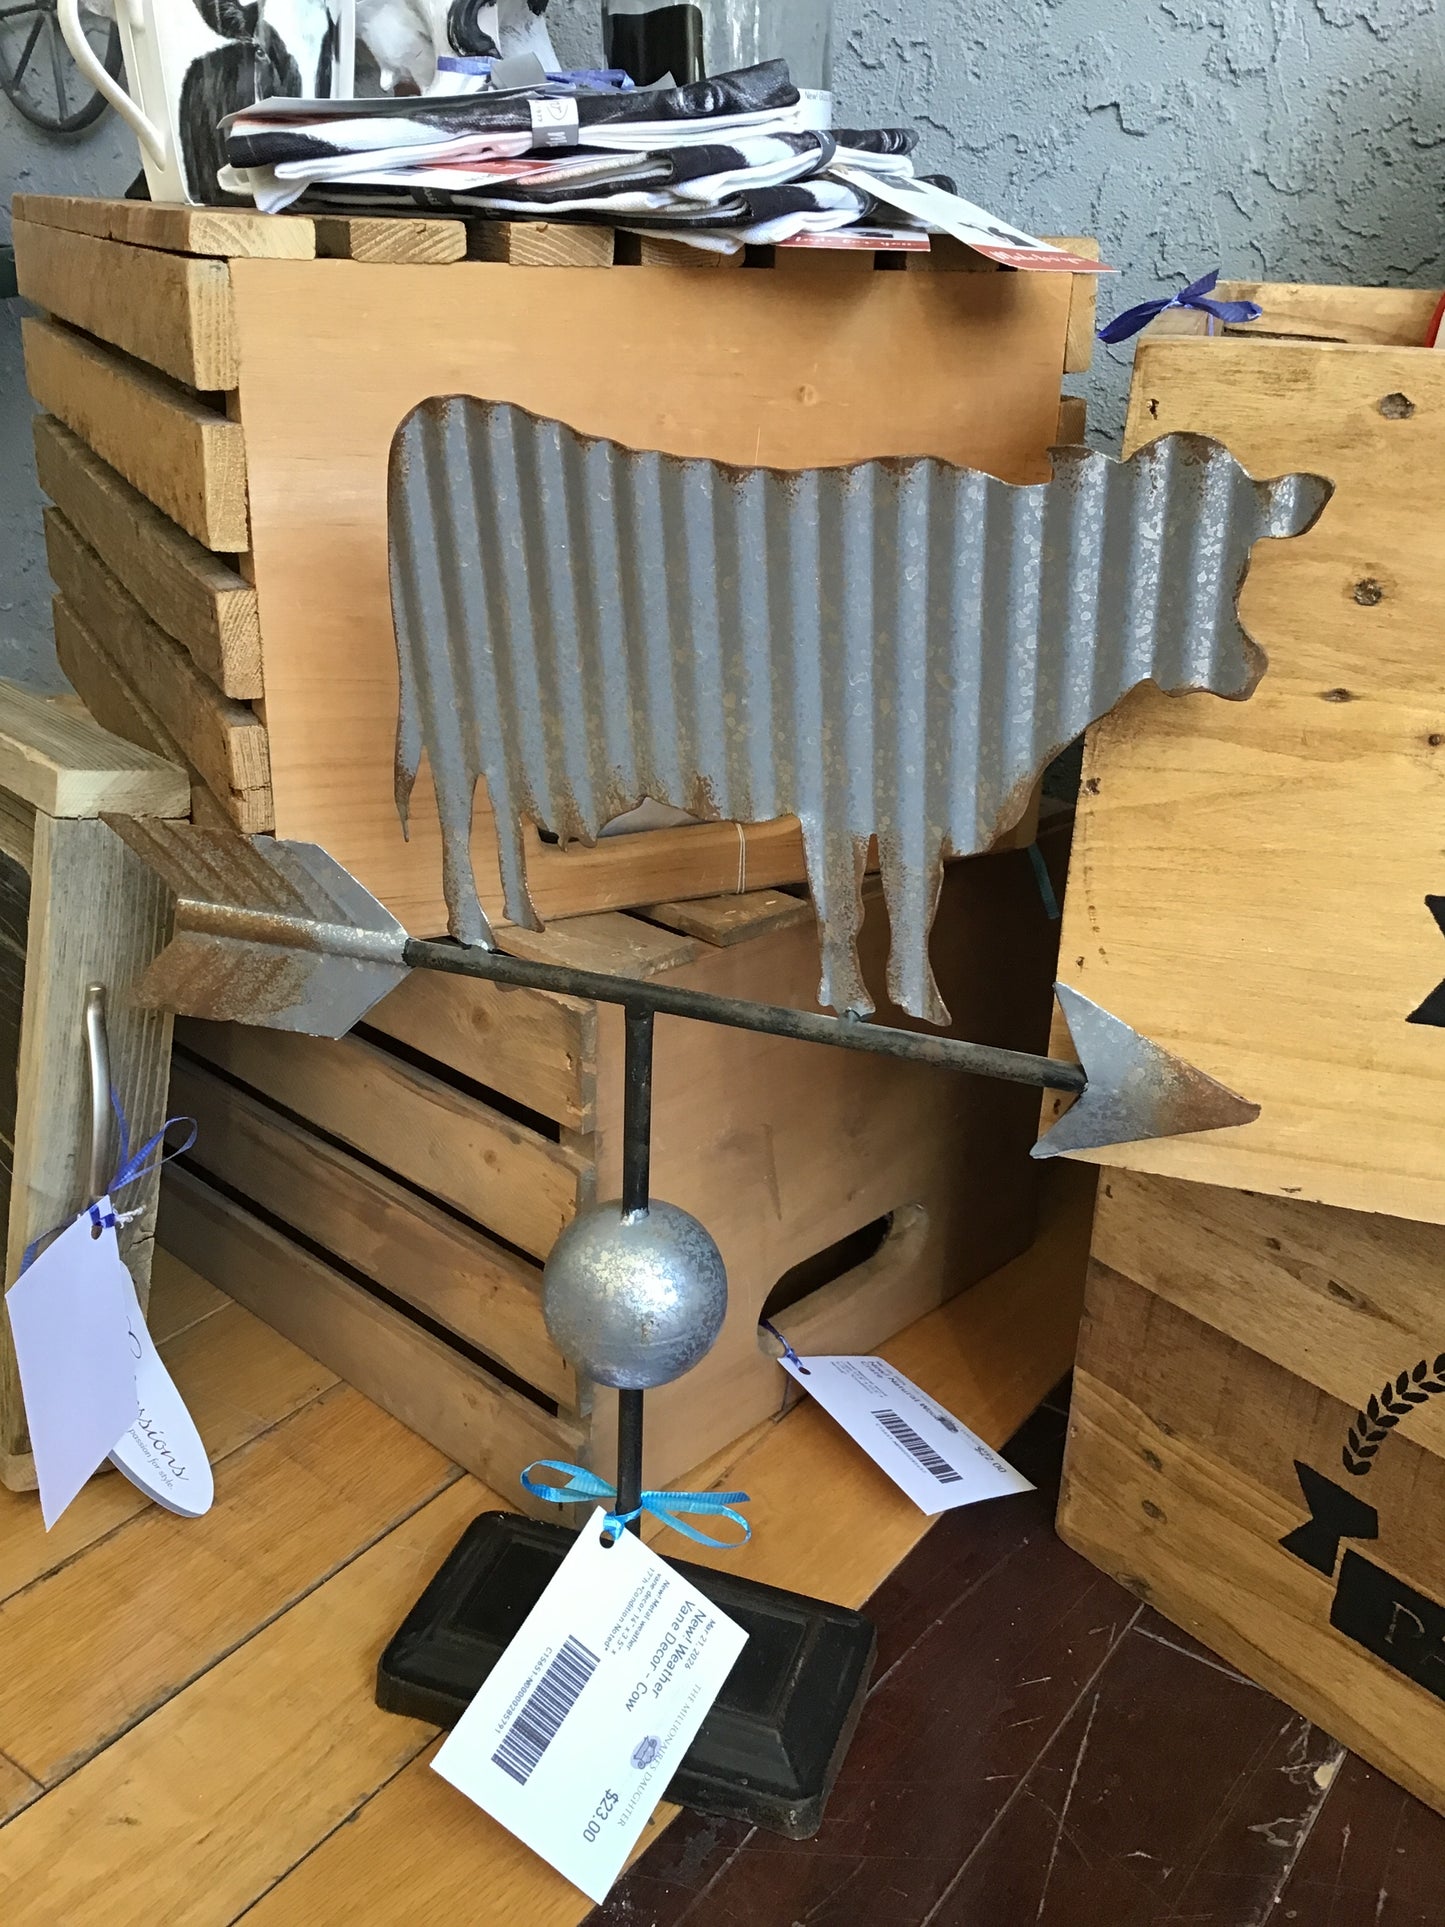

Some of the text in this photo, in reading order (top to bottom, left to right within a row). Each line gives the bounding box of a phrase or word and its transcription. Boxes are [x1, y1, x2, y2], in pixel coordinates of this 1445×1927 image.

[148, 1457, 161, 1471] for
[649, 1572, 661, 1590] vane
[625, 1579, 670, 1652] New! Metal weather
[636, 1589, 652, 1613] decor
[670, 1597, 695, 1634] Vane
[703, 1618, 715, 1635] Mar
[647, 1631, 677, 1674] Decor
[649, 1608, 707, 1701] New! Weather
[683, 1647, 700, 1671] 2026
[624, 1680, 648, 1714] Cow
[686, 1683, 701, 1703] THE
[580, 1786, 620, 1845] $23.00
[616, 1770, 652, 1828] DAUGHTER
